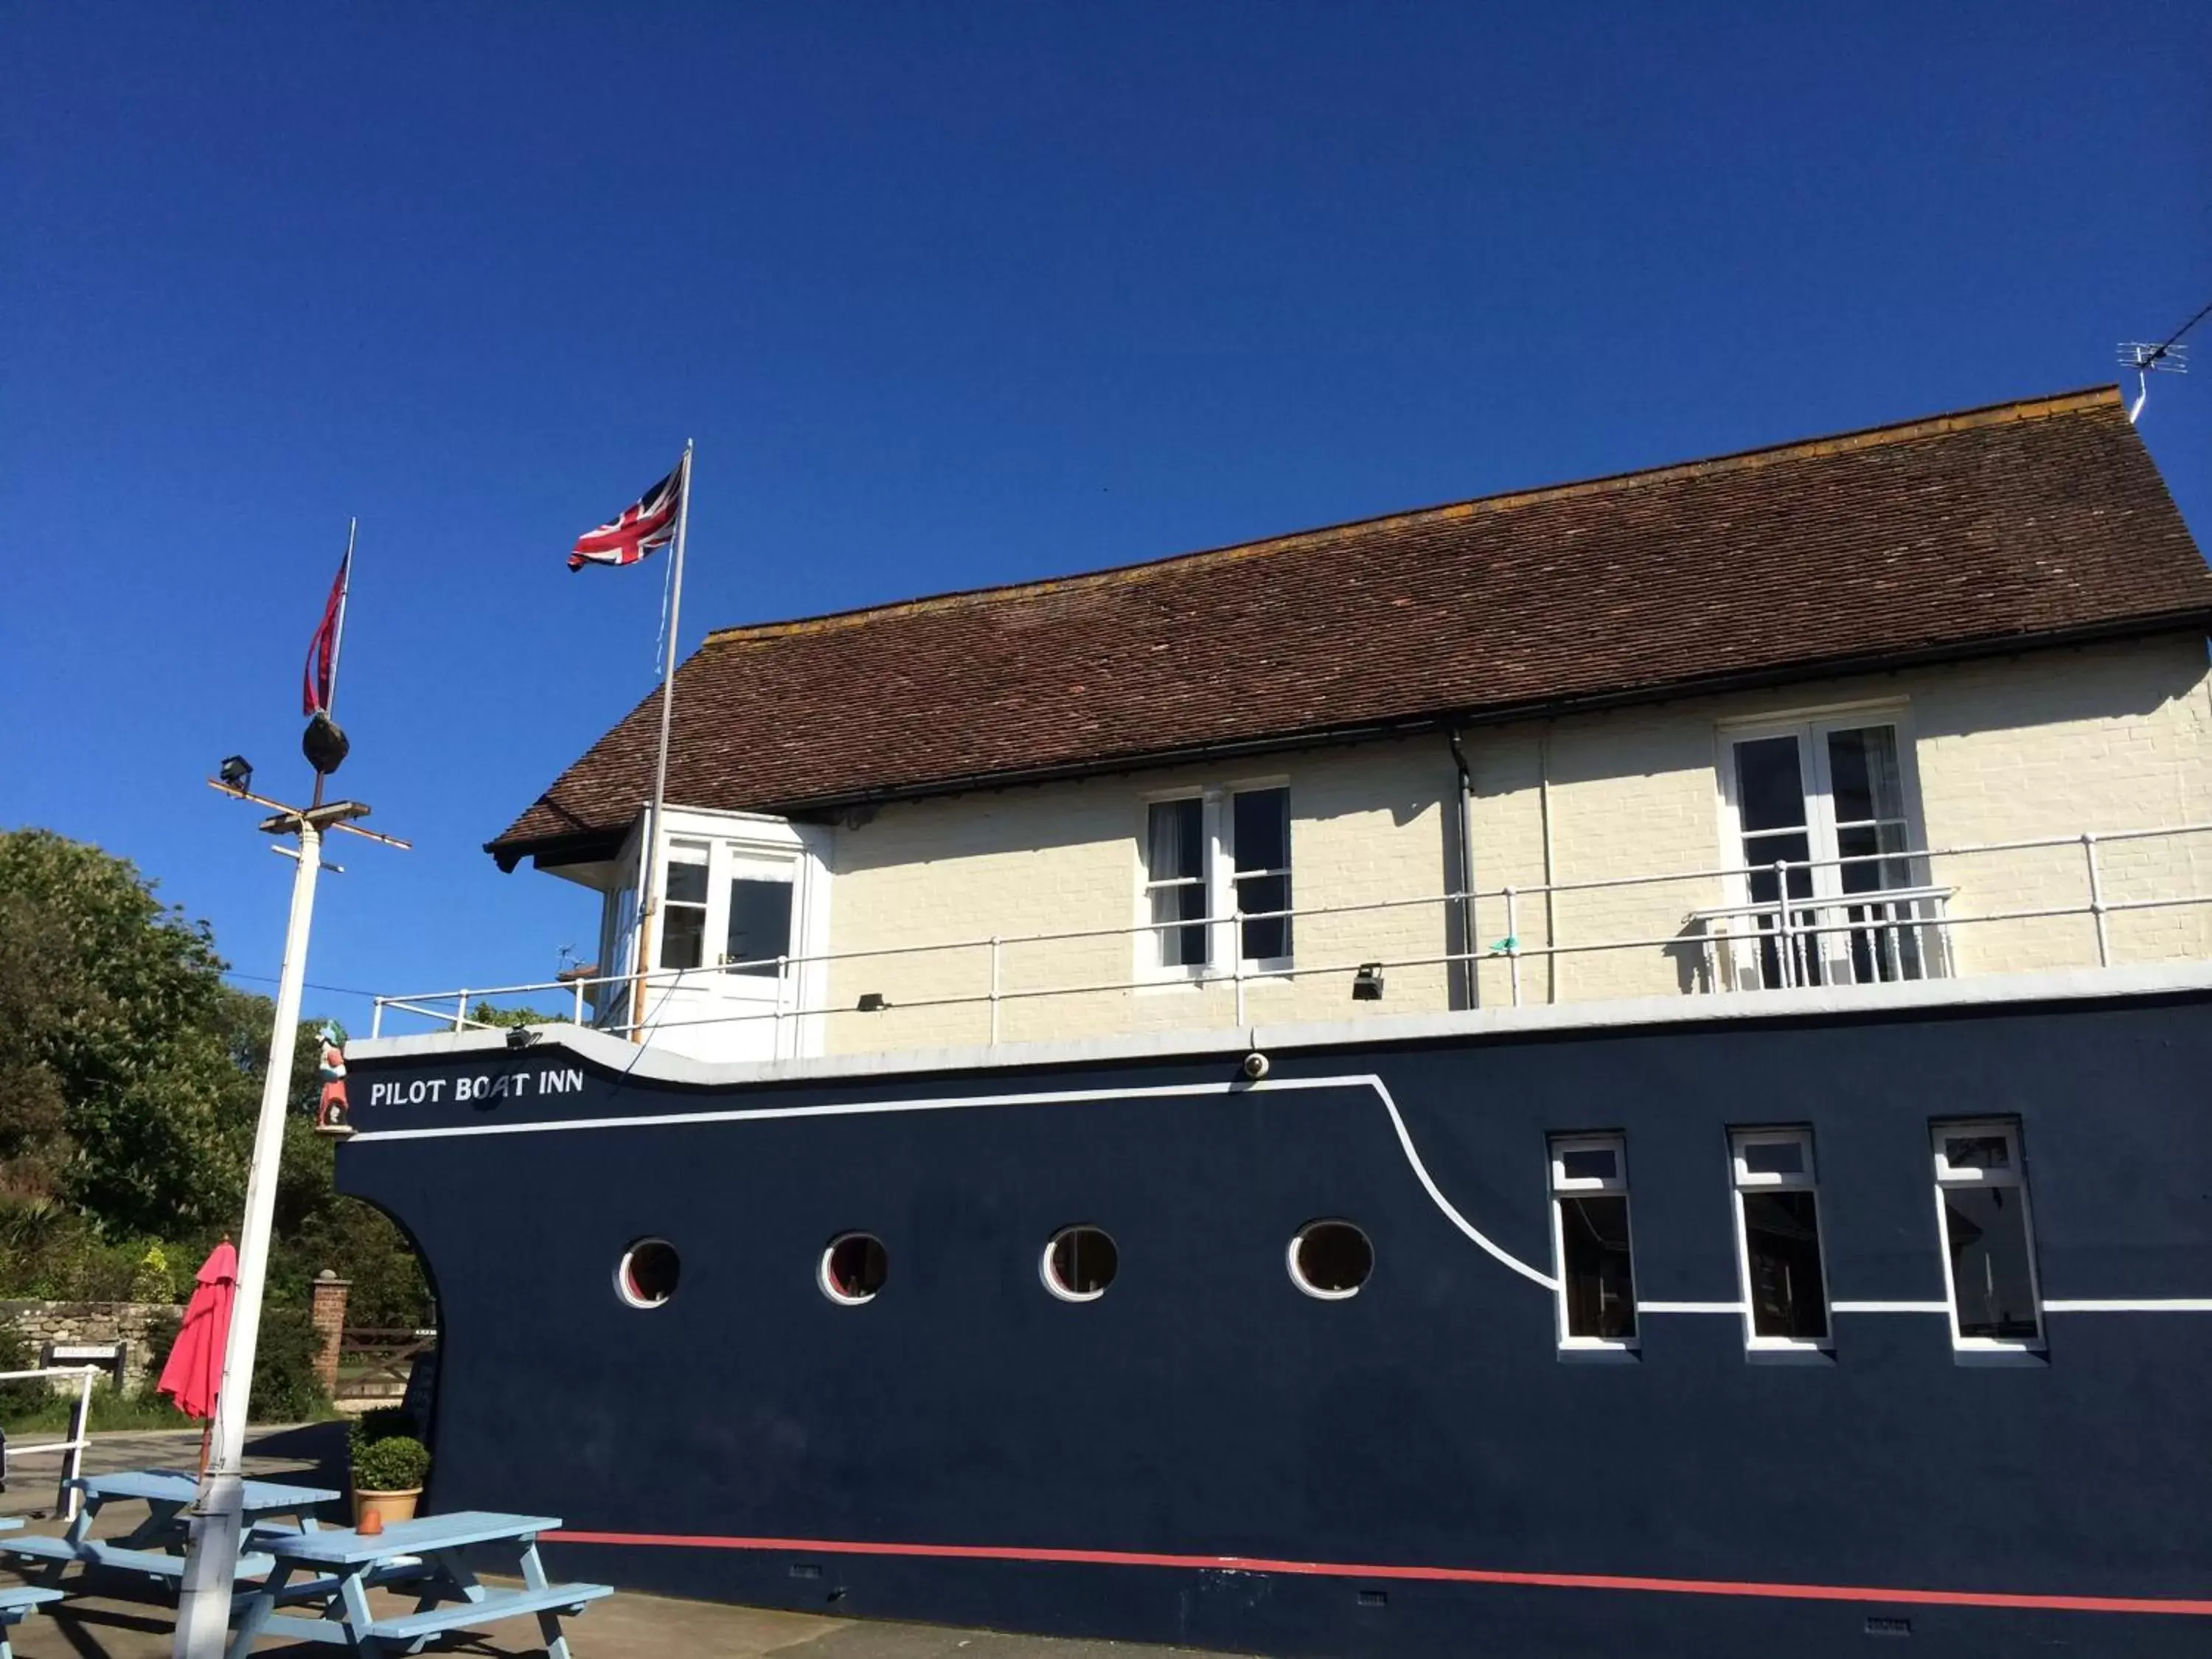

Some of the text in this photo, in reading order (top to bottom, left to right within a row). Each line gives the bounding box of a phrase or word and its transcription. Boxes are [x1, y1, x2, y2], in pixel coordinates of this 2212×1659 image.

[371, 1068, 583, 1106] PILOT BOAT INN
